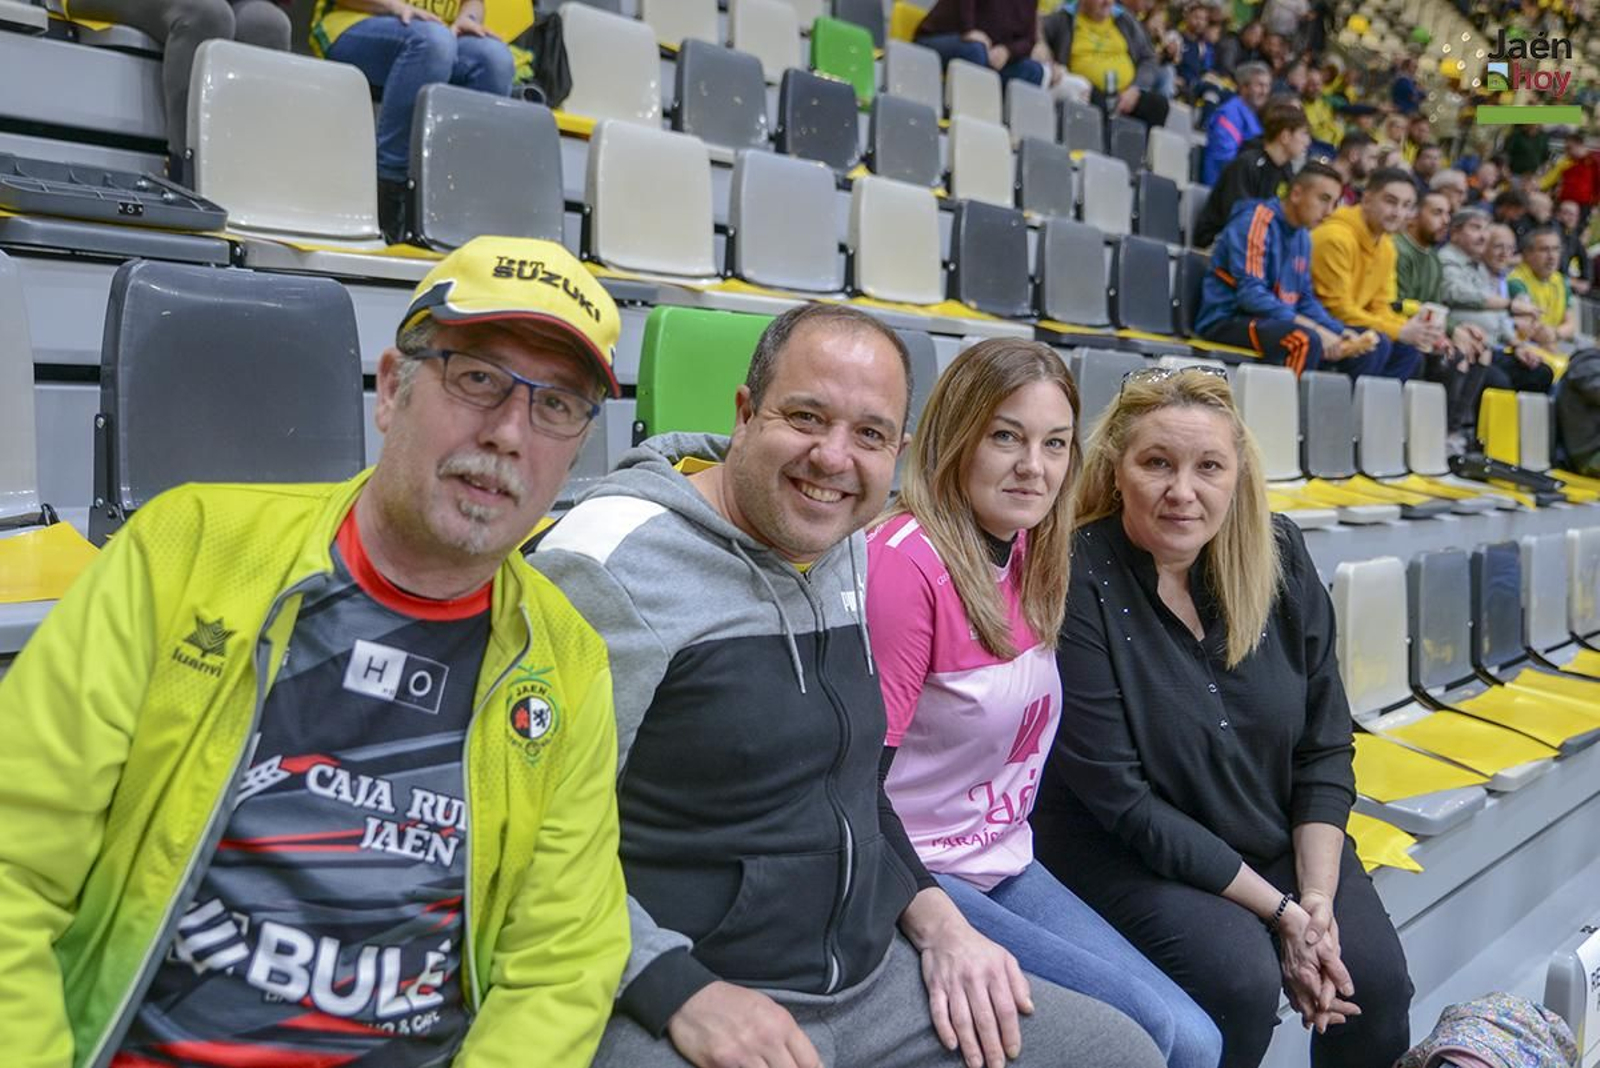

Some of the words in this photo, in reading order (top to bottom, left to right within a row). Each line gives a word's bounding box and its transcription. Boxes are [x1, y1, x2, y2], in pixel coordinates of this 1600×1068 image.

[492, 265, 601, 324] SUZUKI
[305, 763, 396, 814] CAJA
[359, 815, 460, 867] JAÉN
